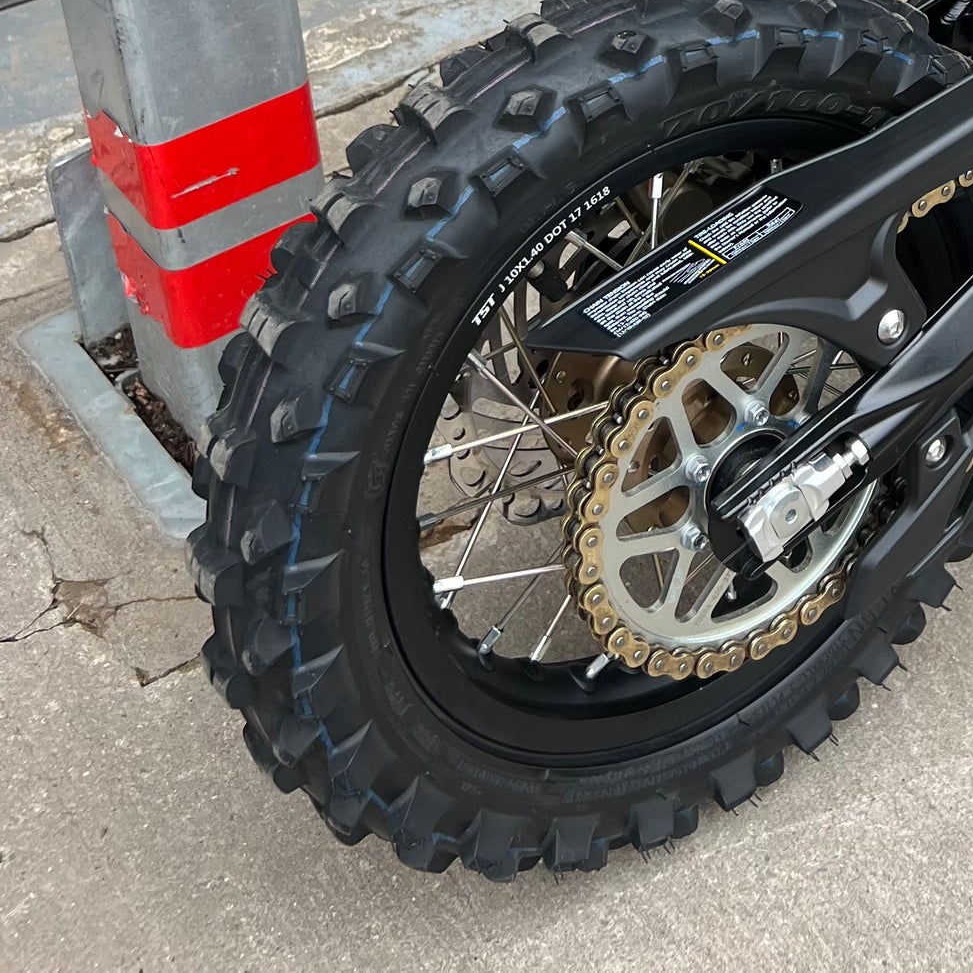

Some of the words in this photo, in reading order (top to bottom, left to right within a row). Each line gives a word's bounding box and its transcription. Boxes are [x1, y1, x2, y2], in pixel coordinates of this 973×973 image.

[661, 89, 897, 139] 70/100-1
[471, 293, 496, 326] TST
[503, 242, 544, 285] 10X1.40
[543, 219, 568, 244] DOT
[568, 206, 582, 223] 17
[583, 186, 611, 210] 1618
